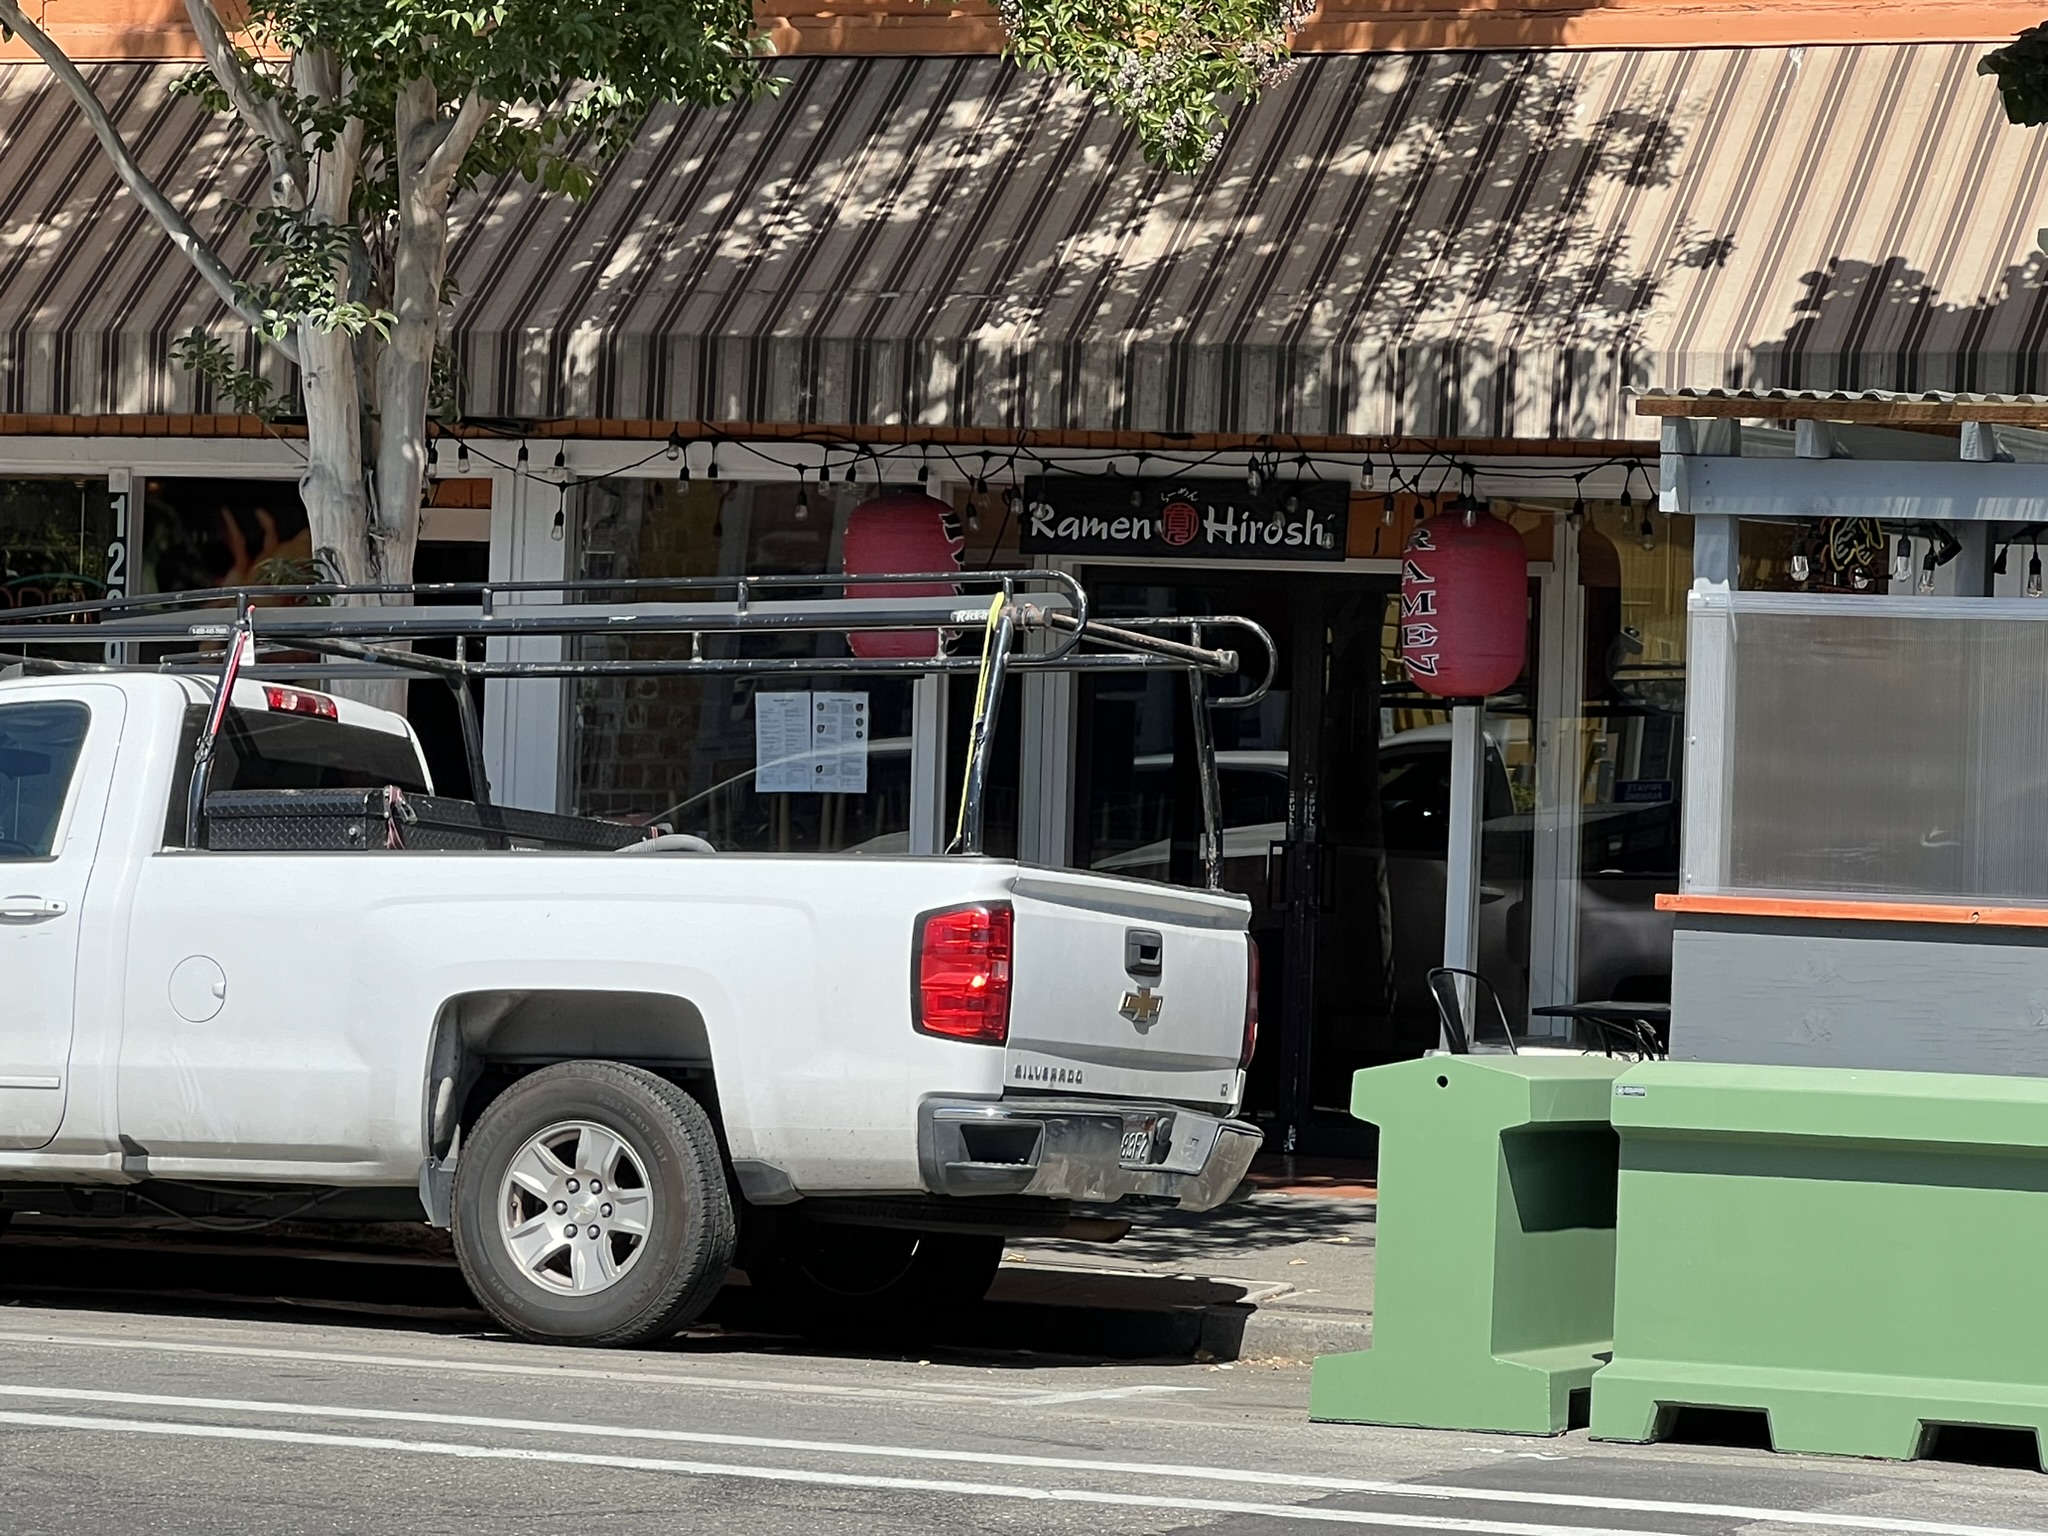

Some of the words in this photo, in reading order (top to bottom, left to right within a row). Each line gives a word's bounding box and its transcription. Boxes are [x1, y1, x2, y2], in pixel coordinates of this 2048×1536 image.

[1029, 501, 1152, 540] Ramen
[1203, 505, 1335, 546] Hirosh
[1014, 1064, 1083, 1085] SILVERADO
